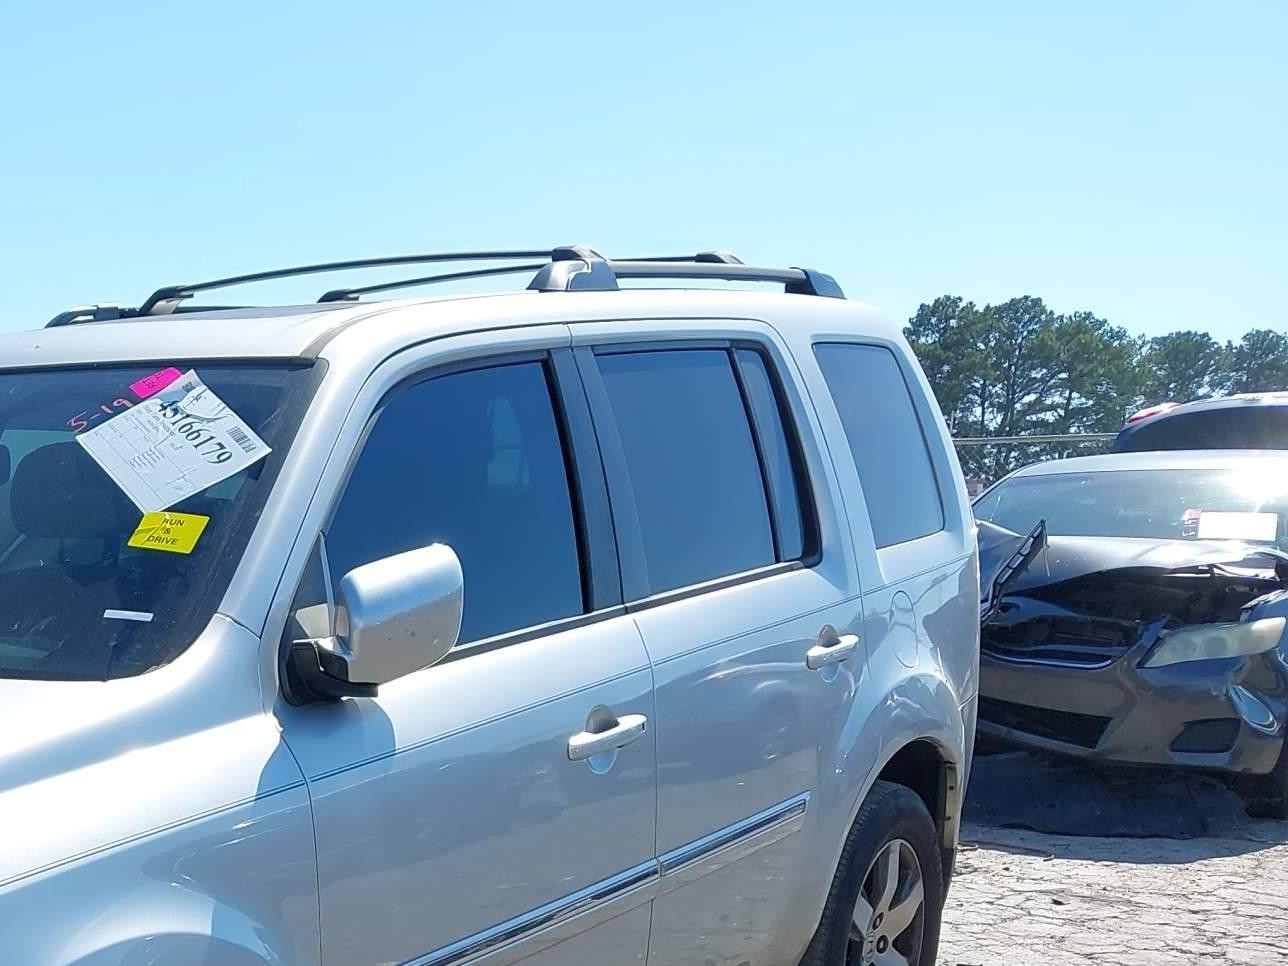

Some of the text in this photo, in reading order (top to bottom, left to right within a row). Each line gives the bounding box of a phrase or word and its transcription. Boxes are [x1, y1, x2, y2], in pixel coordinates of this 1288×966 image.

[66, 398, 134, 433] 5-19
[157, 400, 233, 465] 45166179
[161, 517, 185, 527] RUN
[146, 535, 180, 546] DRIVE
